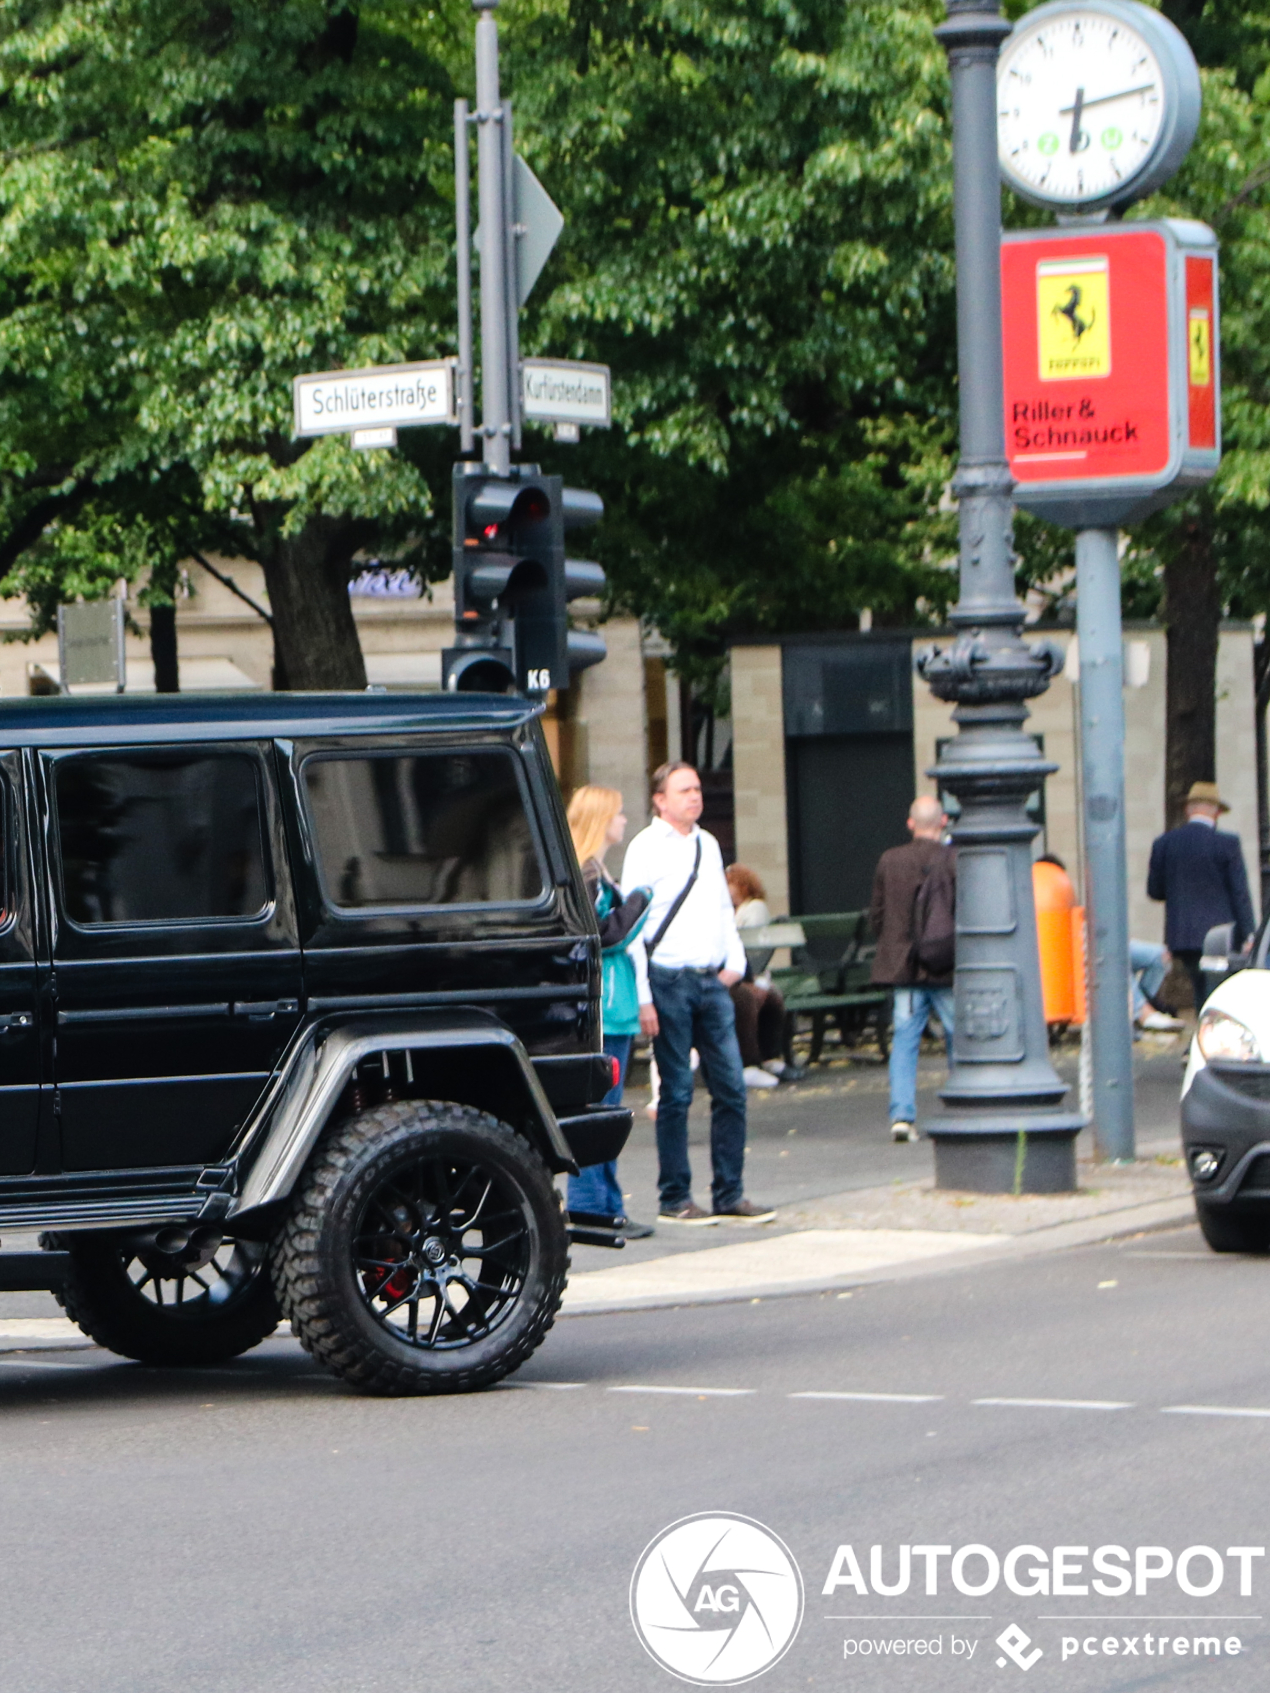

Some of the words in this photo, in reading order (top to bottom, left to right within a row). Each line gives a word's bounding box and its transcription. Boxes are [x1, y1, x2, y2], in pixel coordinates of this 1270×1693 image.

[312, 378, 437, 415] Schlüterstraße
[1013, 400, 1073, 423] Riller
[1079, 397, 1095, 419] &
[1014, 420, 1138, 449] Schnauck
[527, 668, 551, 690] K6
